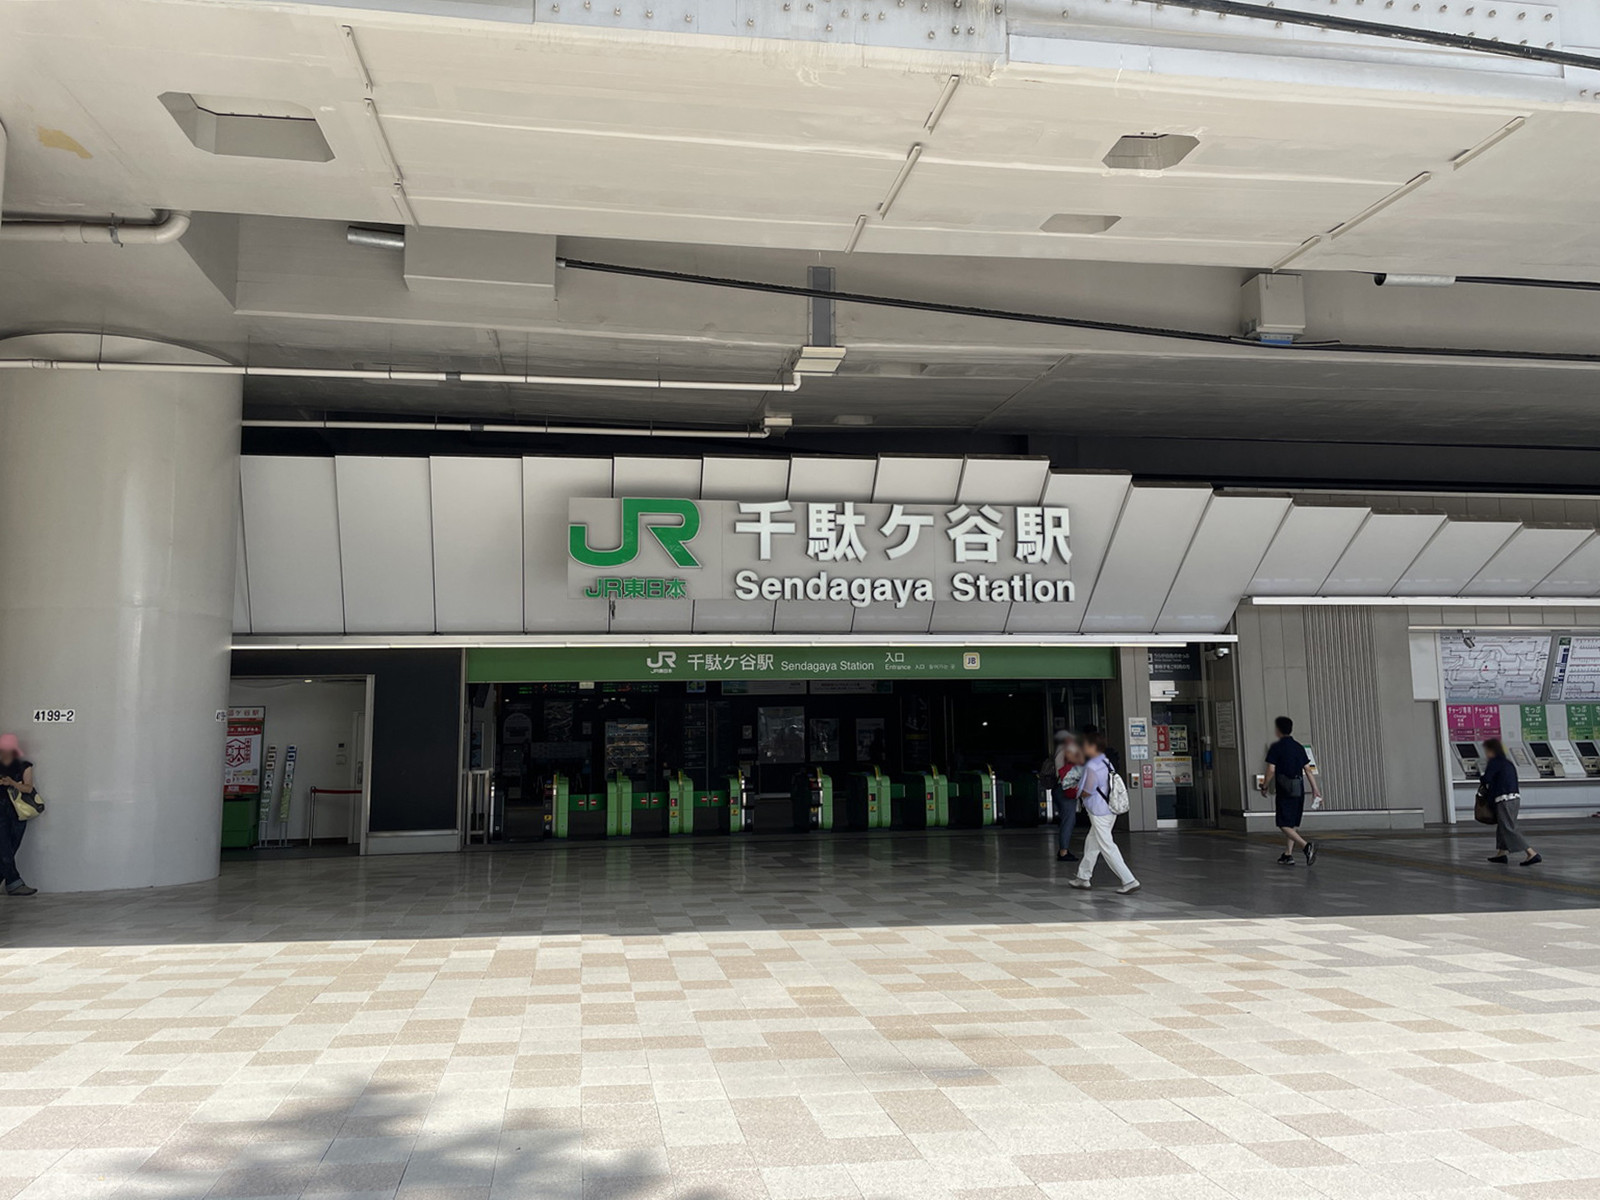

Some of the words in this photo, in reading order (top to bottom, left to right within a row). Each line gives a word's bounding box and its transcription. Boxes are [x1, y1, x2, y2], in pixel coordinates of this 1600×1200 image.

[568, 497, 702, 568] JR
[734, 500, 1072, 564] 千駄ケ谷駅
[585, 577, 687, 599] JR東日本
[735, 569, 935, 608] Sendagaya
[952, 572, 1075, 602] Station
[646, 651, 677, 668] JR
[687, 653, 774, 671] 千駄ケ谷駅
[781, 660, 838, 673] Sendagaya
[840, 660, 875, 671] Station
[884, 652, 905, 663] 入口
[967, 656, 977, 665] JB
[34, 710, 74, 722] 4199-2
